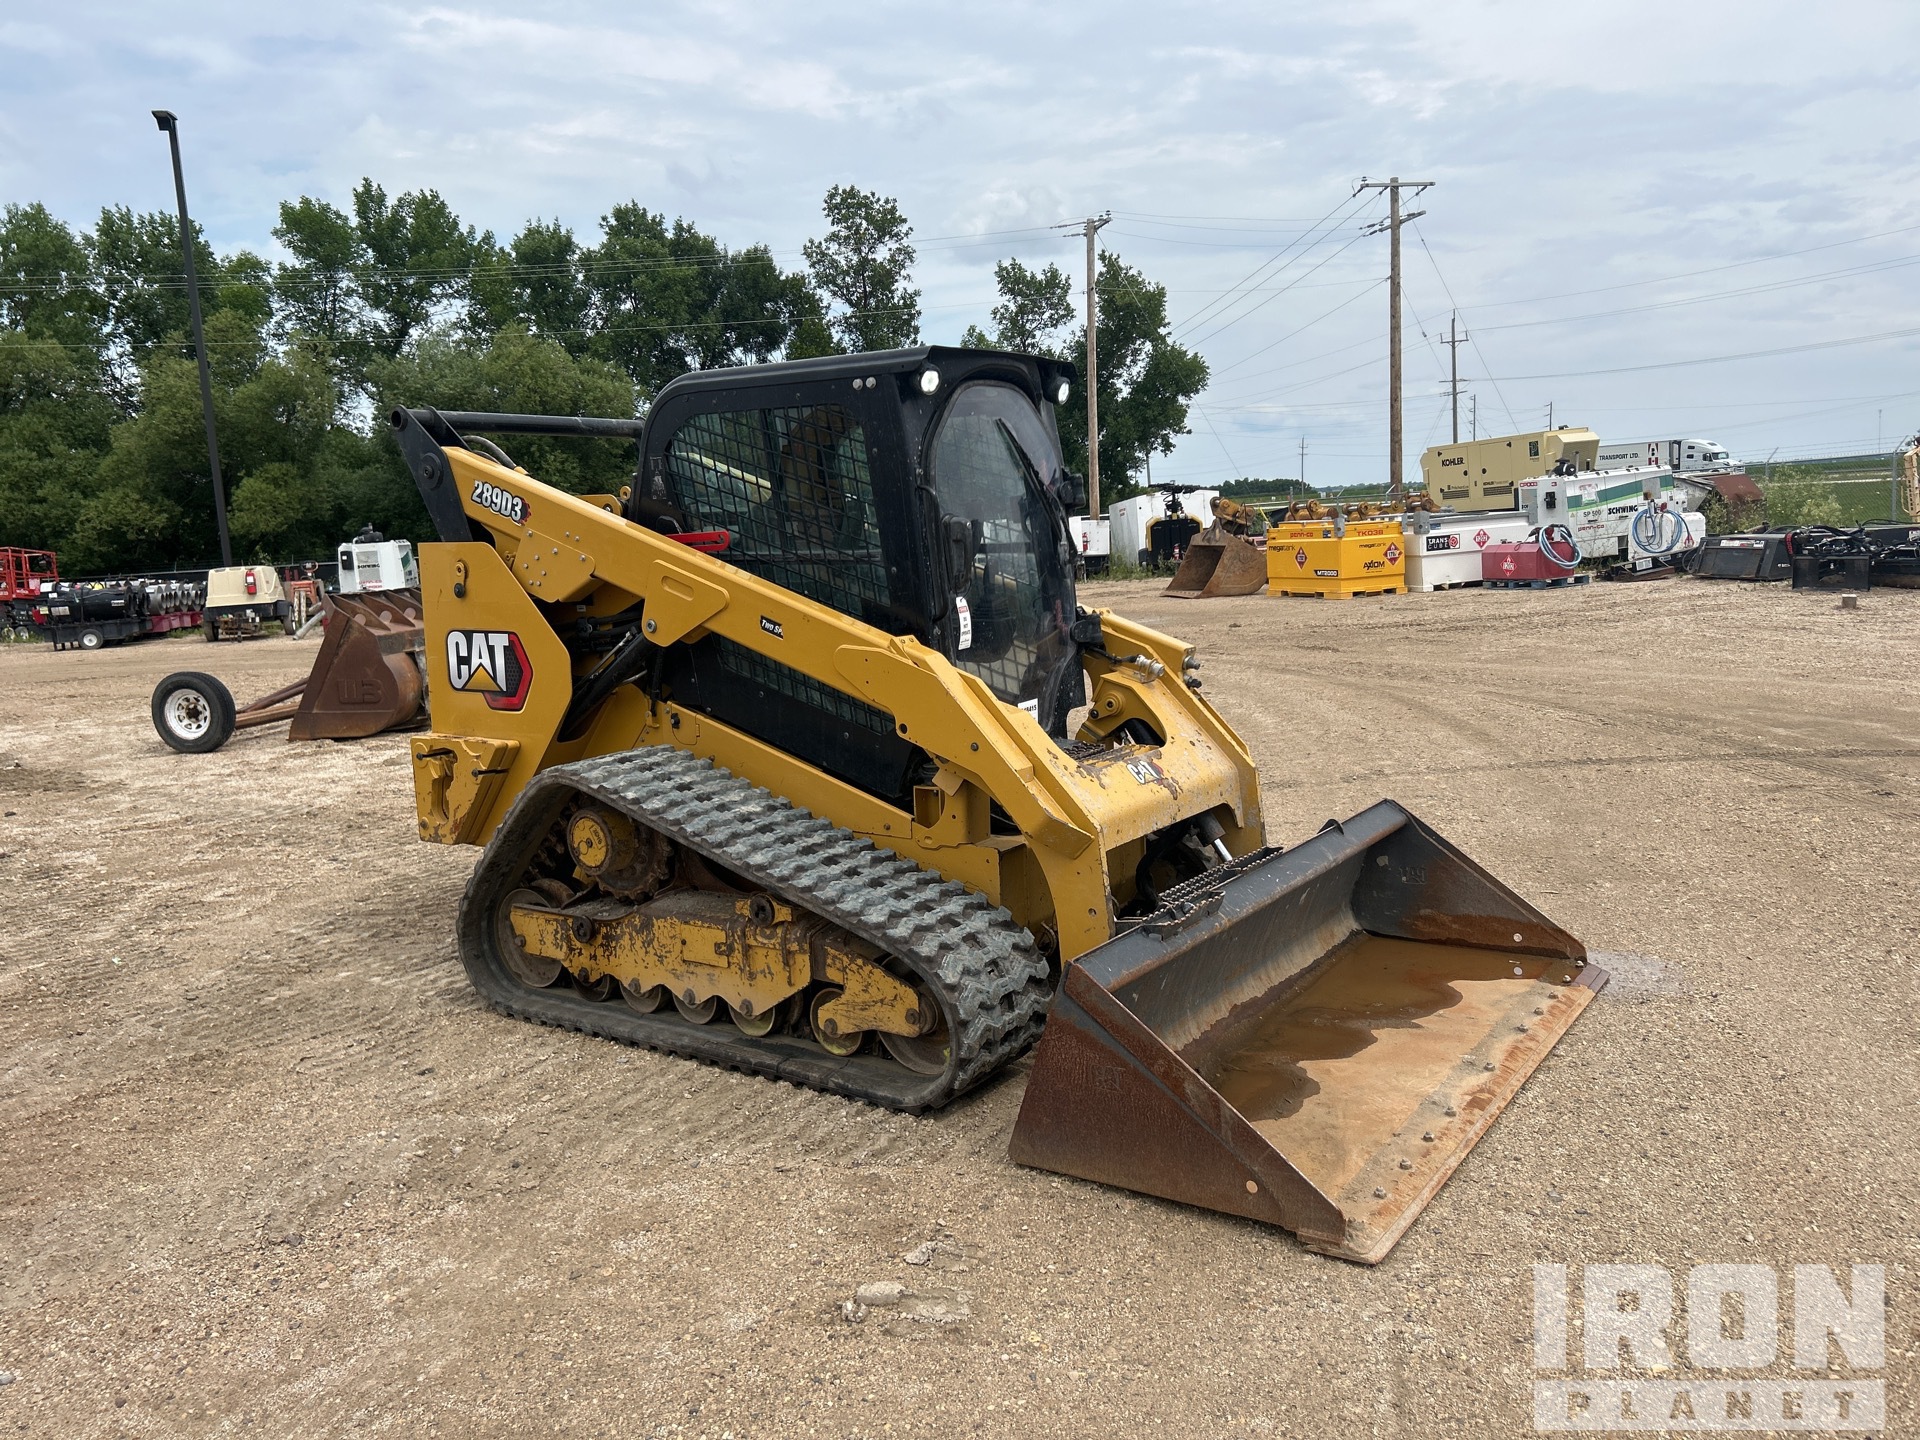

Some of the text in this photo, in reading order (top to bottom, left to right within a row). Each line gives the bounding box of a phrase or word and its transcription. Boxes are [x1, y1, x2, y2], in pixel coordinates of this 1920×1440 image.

[1441, 457, 1465, 467] KOHLER
[1599, 453, 1628, 461] TRANSPORT
[473, 480, 522, 523] 289D3
[1592, 509, 1602, 517] 500
[1608, 504, 1638, 515] SCHWING
[1428, 537, 1448, 545] TRANS
[447, 631, 510, 692] CAT
[1126, 760, 1162, 784] CAT
